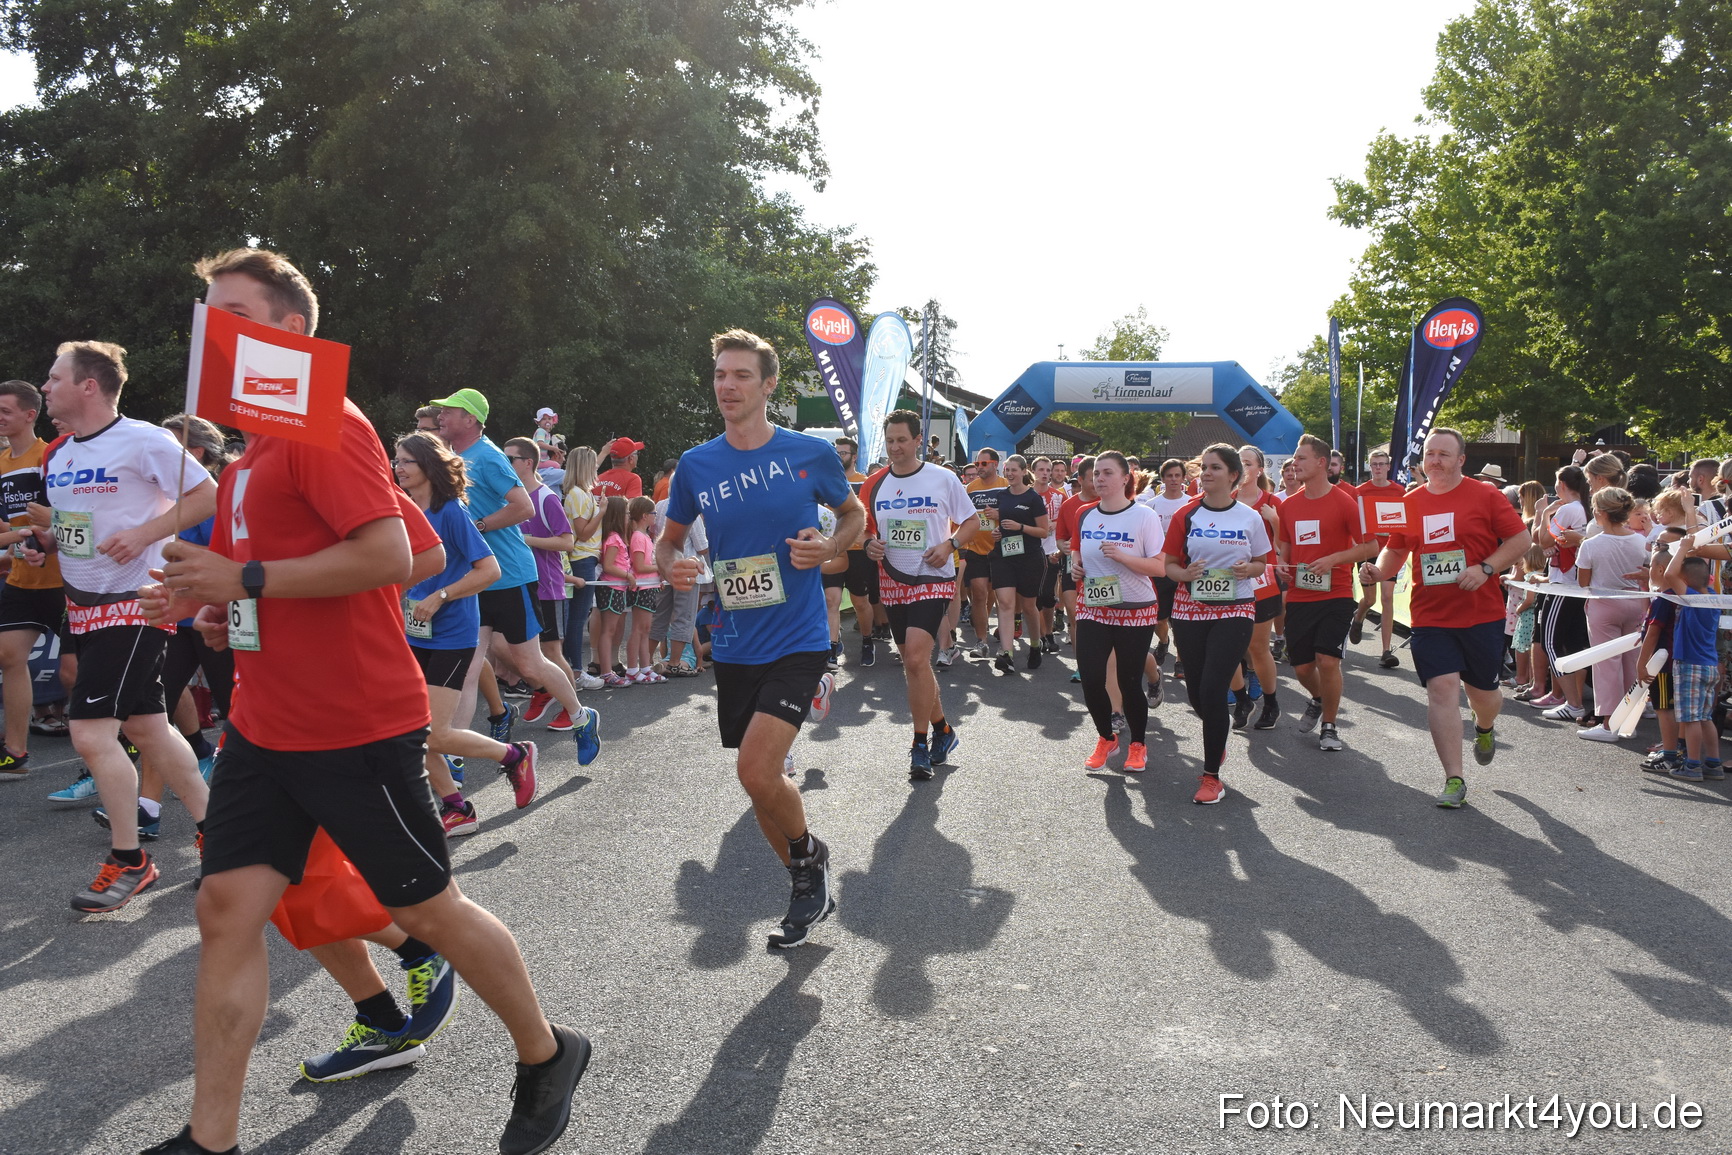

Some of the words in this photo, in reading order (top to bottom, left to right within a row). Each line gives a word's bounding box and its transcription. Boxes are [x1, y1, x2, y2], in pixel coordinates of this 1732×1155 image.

[1429, 319, 1474, 339] Hervis
[256, 383, 283, 391] DEHN
[1115, 386, 1173, 397] firmenlauf
[229, 403, 259, 418] DEHN
[261, 413, 307, 428] protects.
[73, 482, 118, 495] energie
[4, 491, 40, 504] Fischer
[907, 507, 937, 515] energie
[53, 524, 85, 545] 2075
[891, 530, 921, 541] 2076
[1003, 542, 1020, 551] 1381
[1427, 562, 1461, 576] 2444
[724, 573, 773, 596] 2045
[1302, 573, 1323, 585] 493
[1087, 586, 1115, 598] 2061
[1196, 580, 1230, 592] 2062
